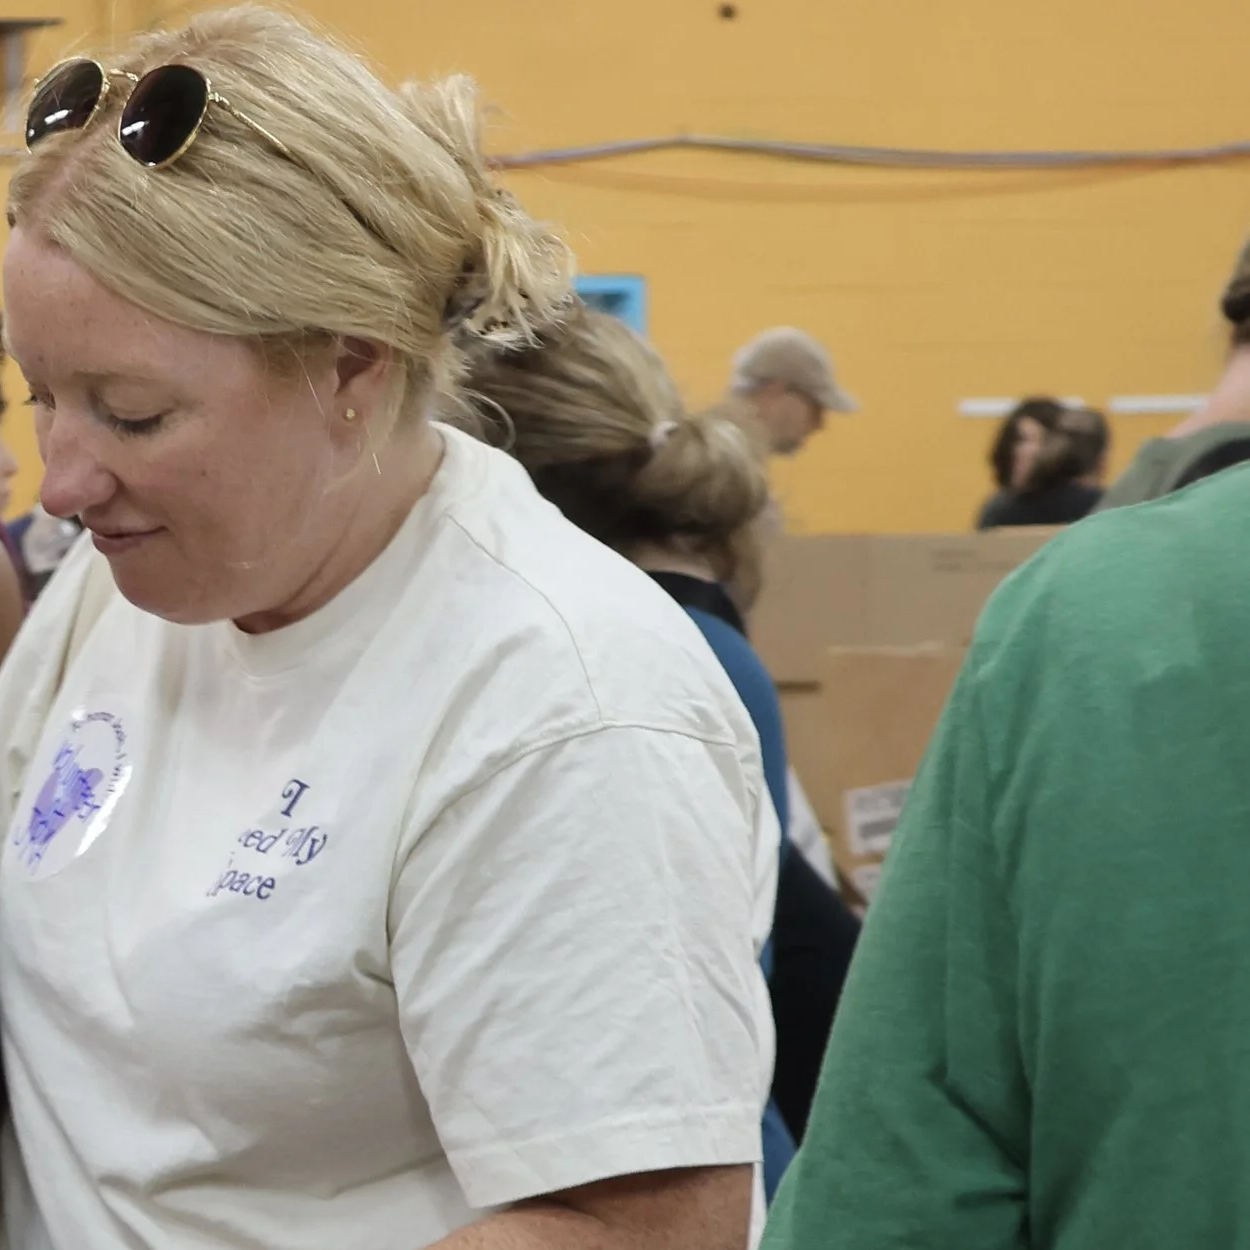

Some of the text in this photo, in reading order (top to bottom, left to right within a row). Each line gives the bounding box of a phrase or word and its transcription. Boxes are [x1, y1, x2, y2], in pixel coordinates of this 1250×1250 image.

[280, 779, 310, 818] I
[238, 828, 288, 854] ed
[207, 862, 276, 900] pace
